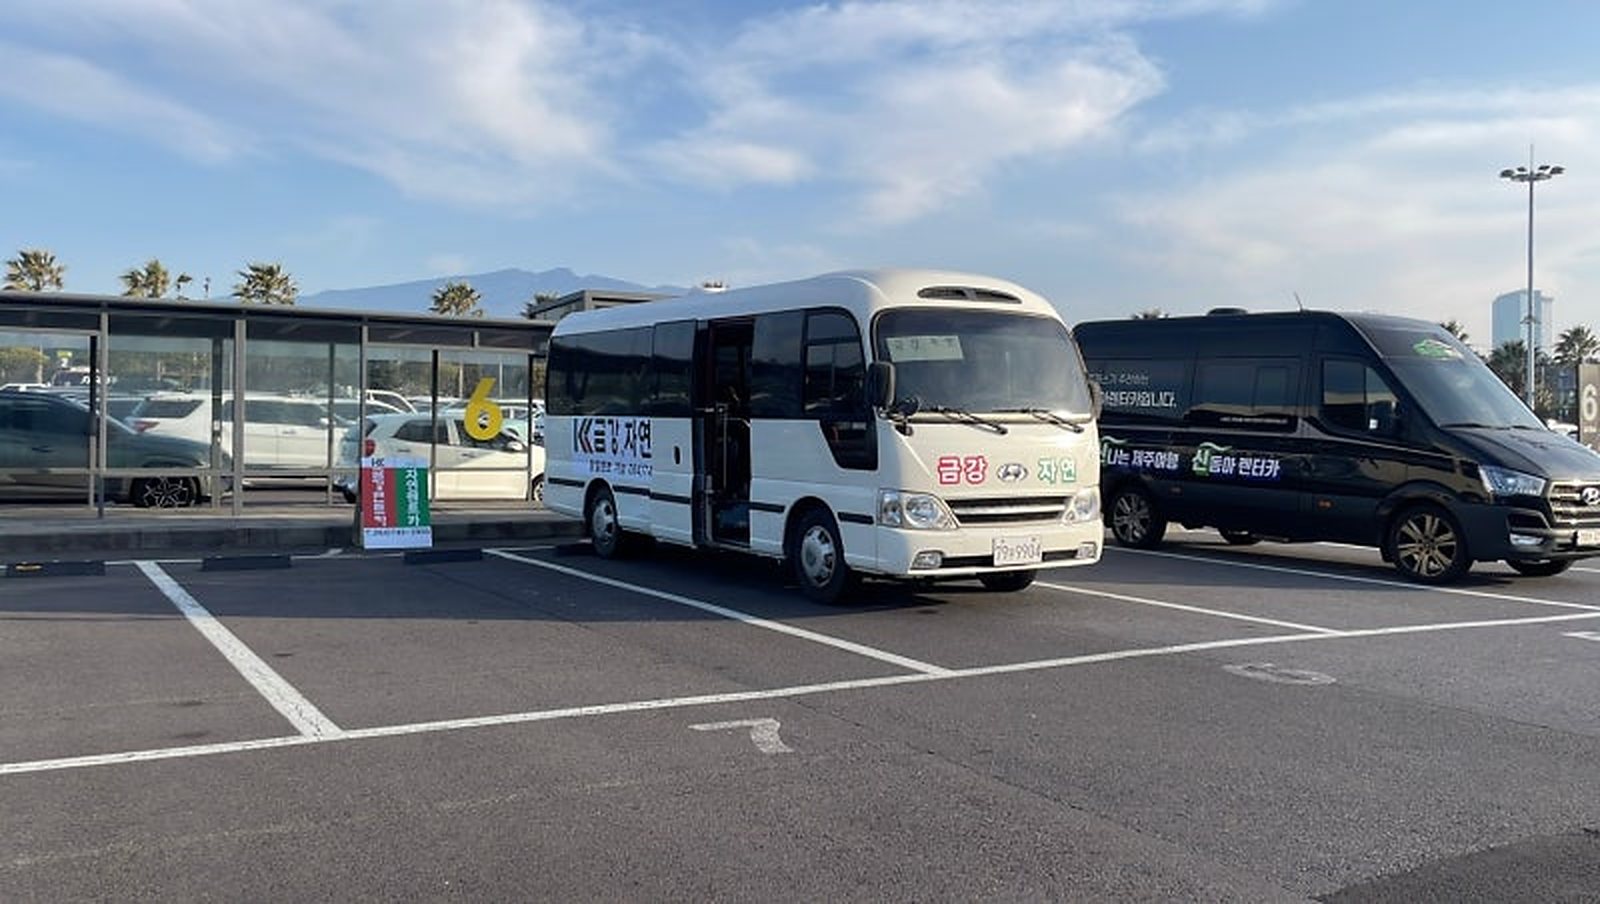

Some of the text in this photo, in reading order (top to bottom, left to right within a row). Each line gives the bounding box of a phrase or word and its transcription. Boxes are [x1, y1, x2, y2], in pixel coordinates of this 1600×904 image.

[464, 376, 503, 441] 6
[1583, 383, 1598, 421] 6
[594, 418, 652, 459] 금강 자연
[937, 456, 987, 484] 금강
[1037, 458, 1077, 483] 자연
[1131, 450, 1180, 471] 제주여행
[1238, 457, 1281, 478] 렌터카
[688, 718, 794, 753] 7
